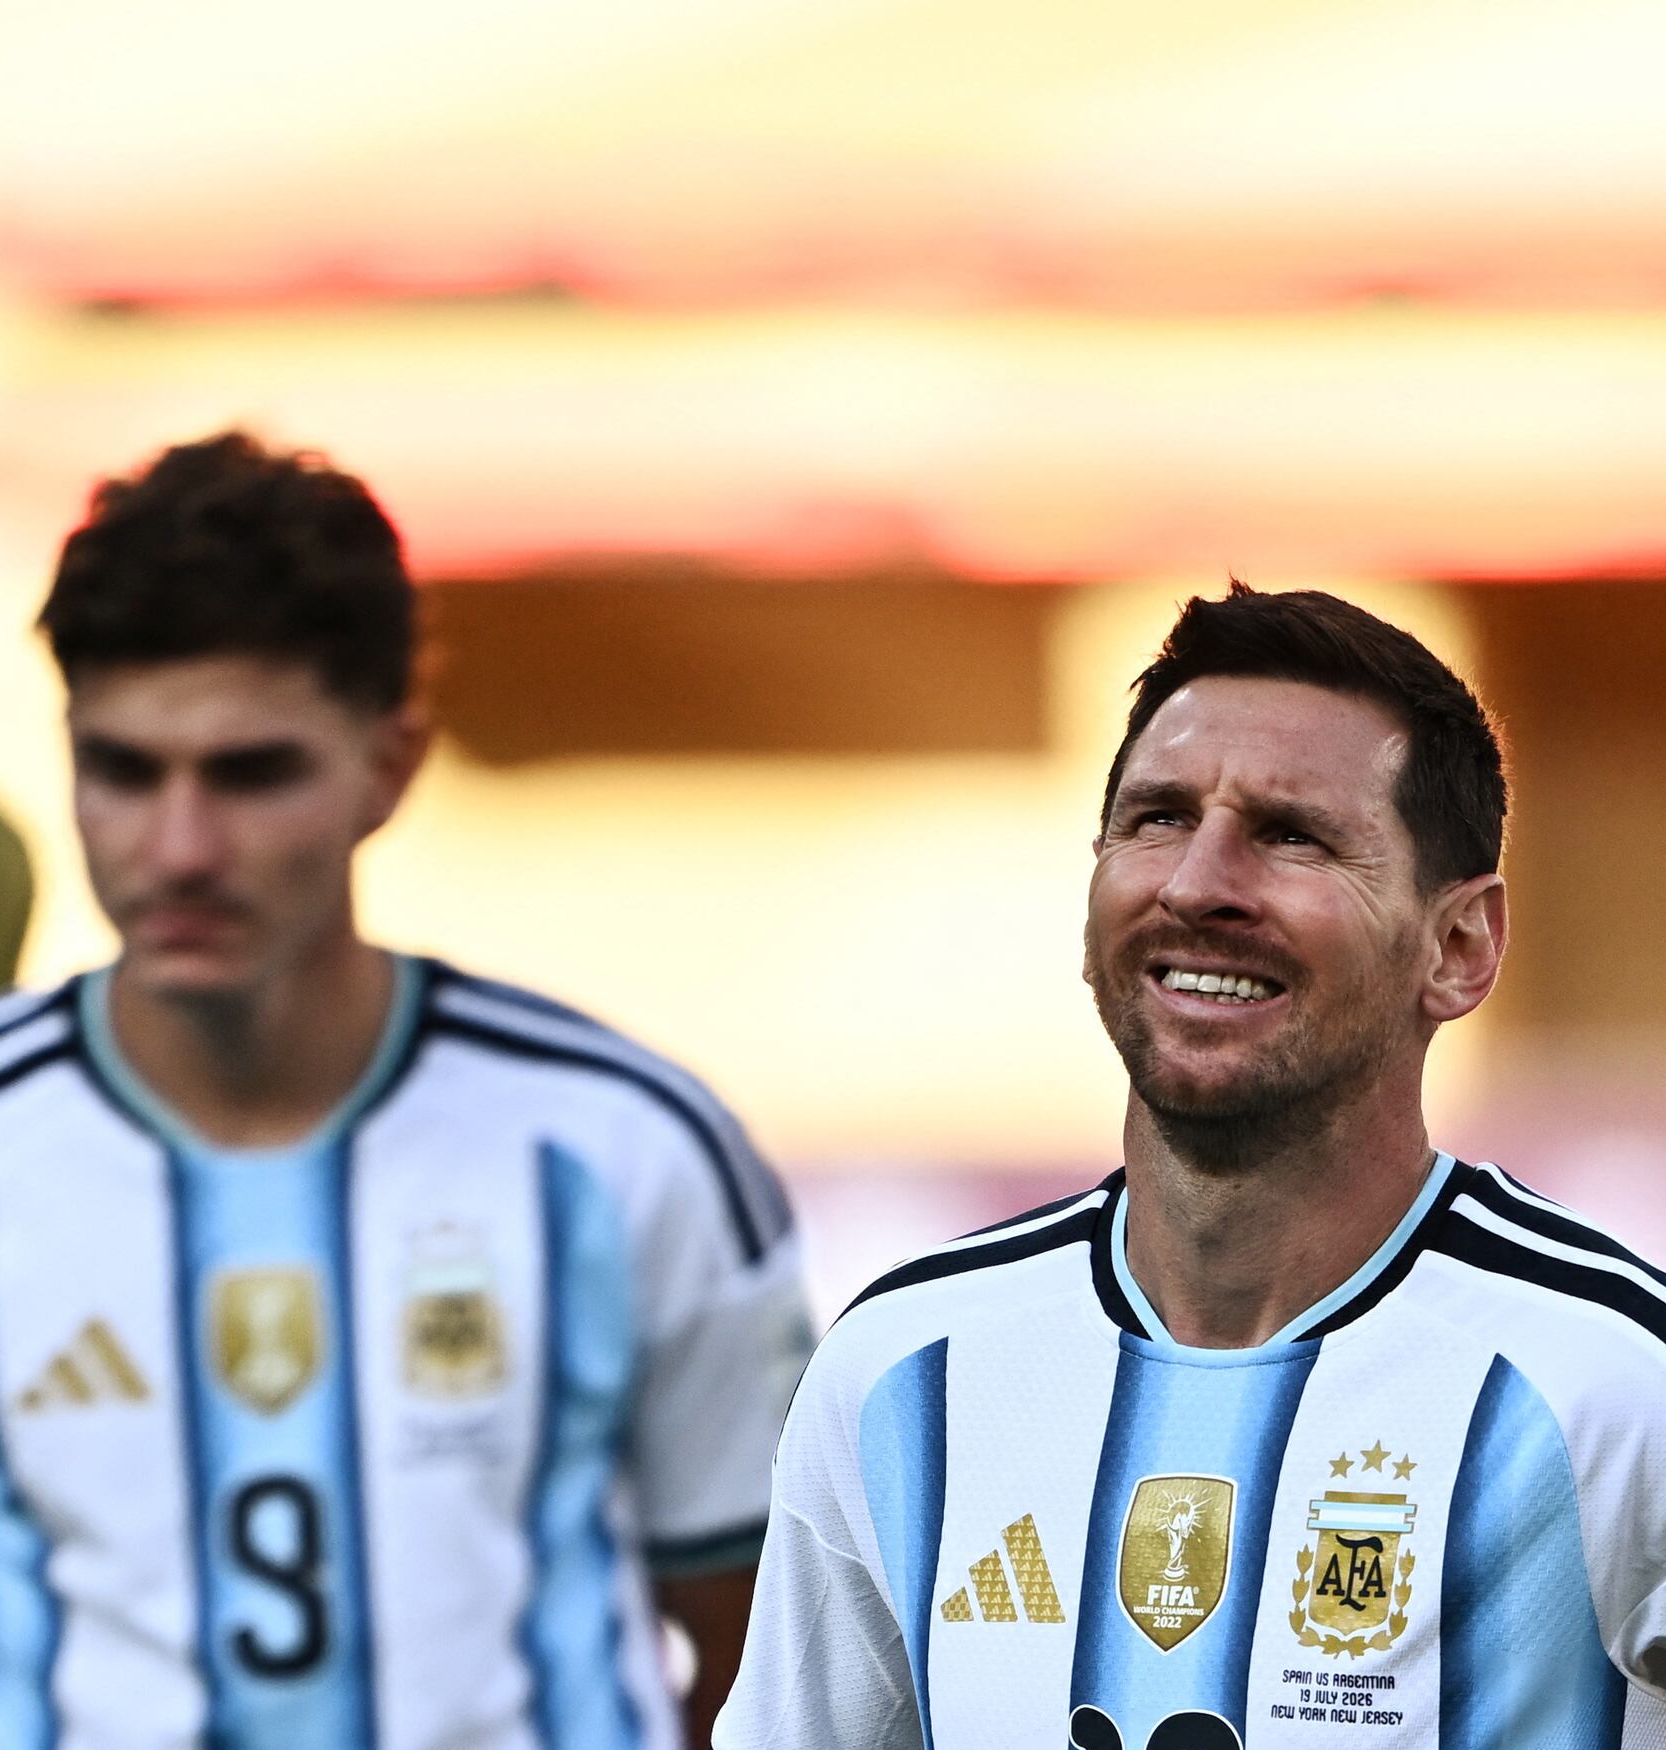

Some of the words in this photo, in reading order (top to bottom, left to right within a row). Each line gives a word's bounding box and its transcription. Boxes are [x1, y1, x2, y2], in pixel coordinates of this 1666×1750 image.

[227, 1473, 331, 1678] 9
[1316, 1534, 1386, 1611] AFA
[1147, 1585, 1195, 1606] FIFA
[1133, 1606, 1160, 1614] WORLD
[1162, 1607, 1204, 1616] CHAMPIONS
[1153, 1616, 1182, 1628] 2022
[1282, 1669, 1312, 1684] SPAIN
[1333, 1673, 1395, 1690] ARGENTINA
[1300, 1689, 1311, 1702] 19
[1314, 1690, 1338, 1704] JULY
[1342, 1692, 1373, 1706] 2026
[1271, 1705, 1295, 1719] NEW
[1299, 1707, 1326, 1721] YORK
[1330, 1709, 1357, 1724] NEW
[1361, 1711, 1403, 1725] JERSEY
